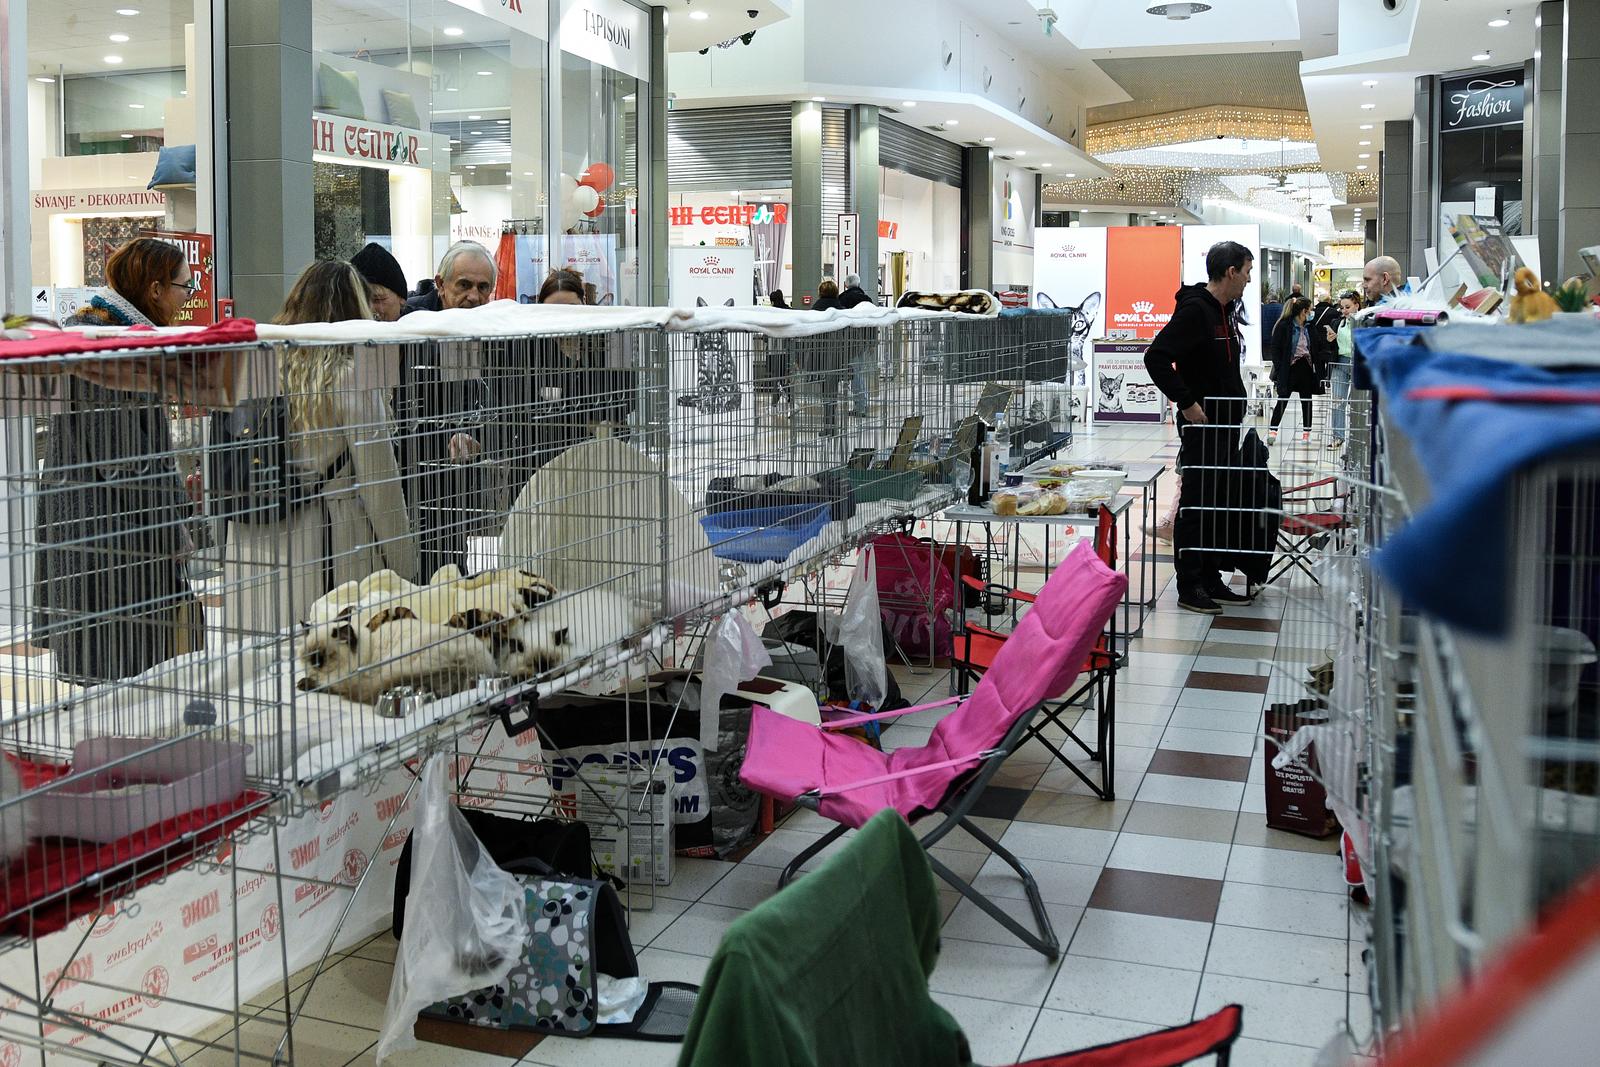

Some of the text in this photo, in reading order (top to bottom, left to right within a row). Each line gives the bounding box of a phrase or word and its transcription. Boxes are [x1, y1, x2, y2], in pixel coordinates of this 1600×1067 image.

[584, 9, 631, 49] TAPISONI
[1449, 92, 1512, 126] Fashion
[35, 192, 166, 210] ŠIVANJE DEKORATIVNE
[689, 267, 734, 275] ROYAL CANIN
[1113, 313, 1172, 322] ROYAL CANIN
[1285, 773, 1314, 782] POPUSTA
